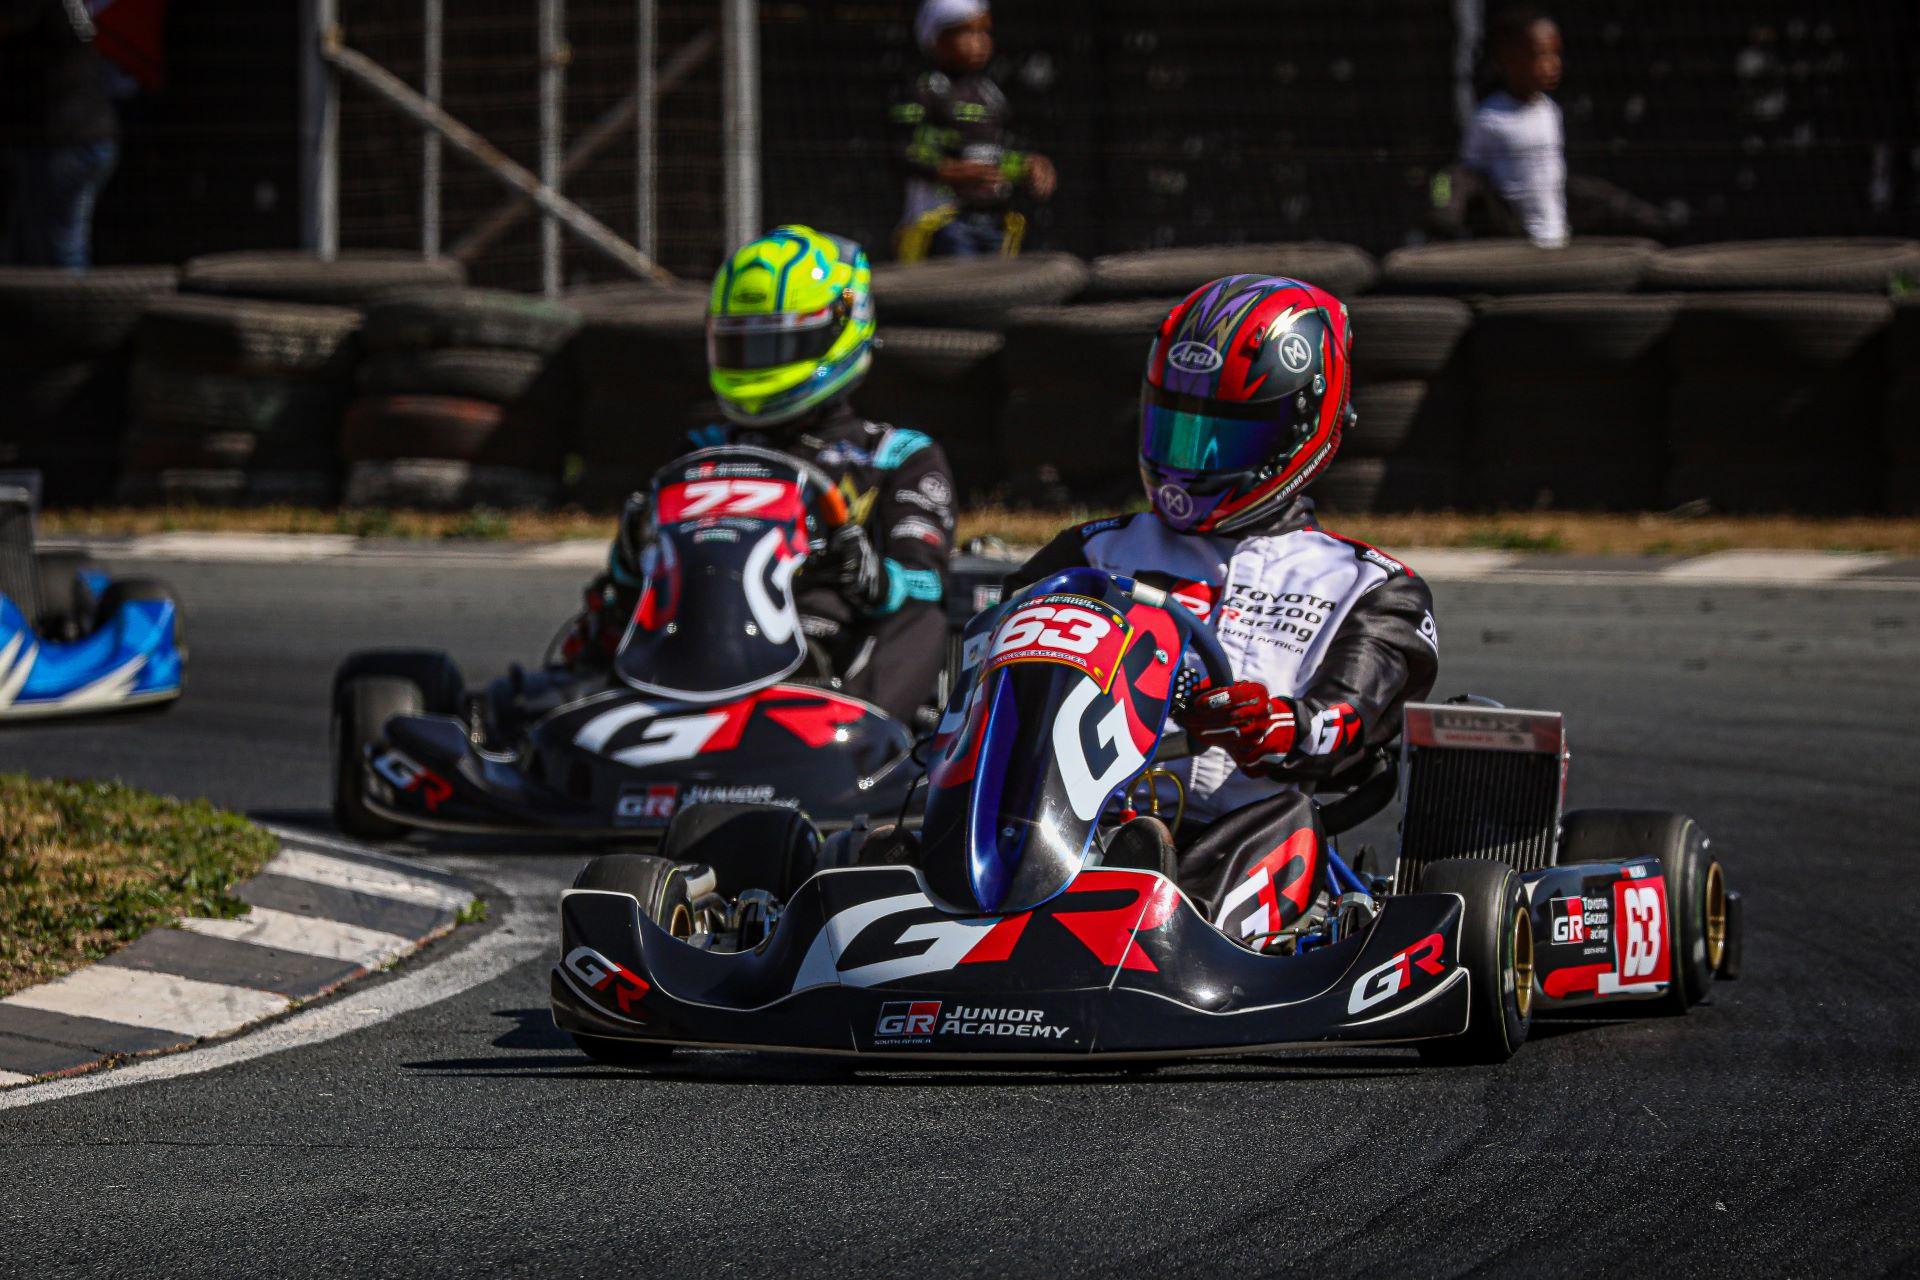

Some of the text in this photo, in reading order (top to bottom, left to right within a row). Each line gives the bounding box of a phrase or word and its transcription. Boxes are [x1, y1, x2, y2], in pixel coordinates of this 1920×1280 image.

[1173, 343, 1216, 367] Arai
[679, 480, 786, 519] 77
[1224, 596, 1322, 624] GAZOO
[1231, 583, 1337, 611] TOYOTA
[988, 606, 1111, 659] 63
[1258, 634, 1305, 655] AFRICA
[791, 870, 1181, 992] GR
[1553, 915, 1584, 941] GR
[1623, 887, 1661, 978] 63
[565, 946, 650, 1014] GR
[1348, 932, 1446, 1015] GR
[878, 1014, 935, 1034] GR
[945, 1005, 1044, 1023] JUNIOR
[939, 1020, 1070, 1039] ACADEMY
